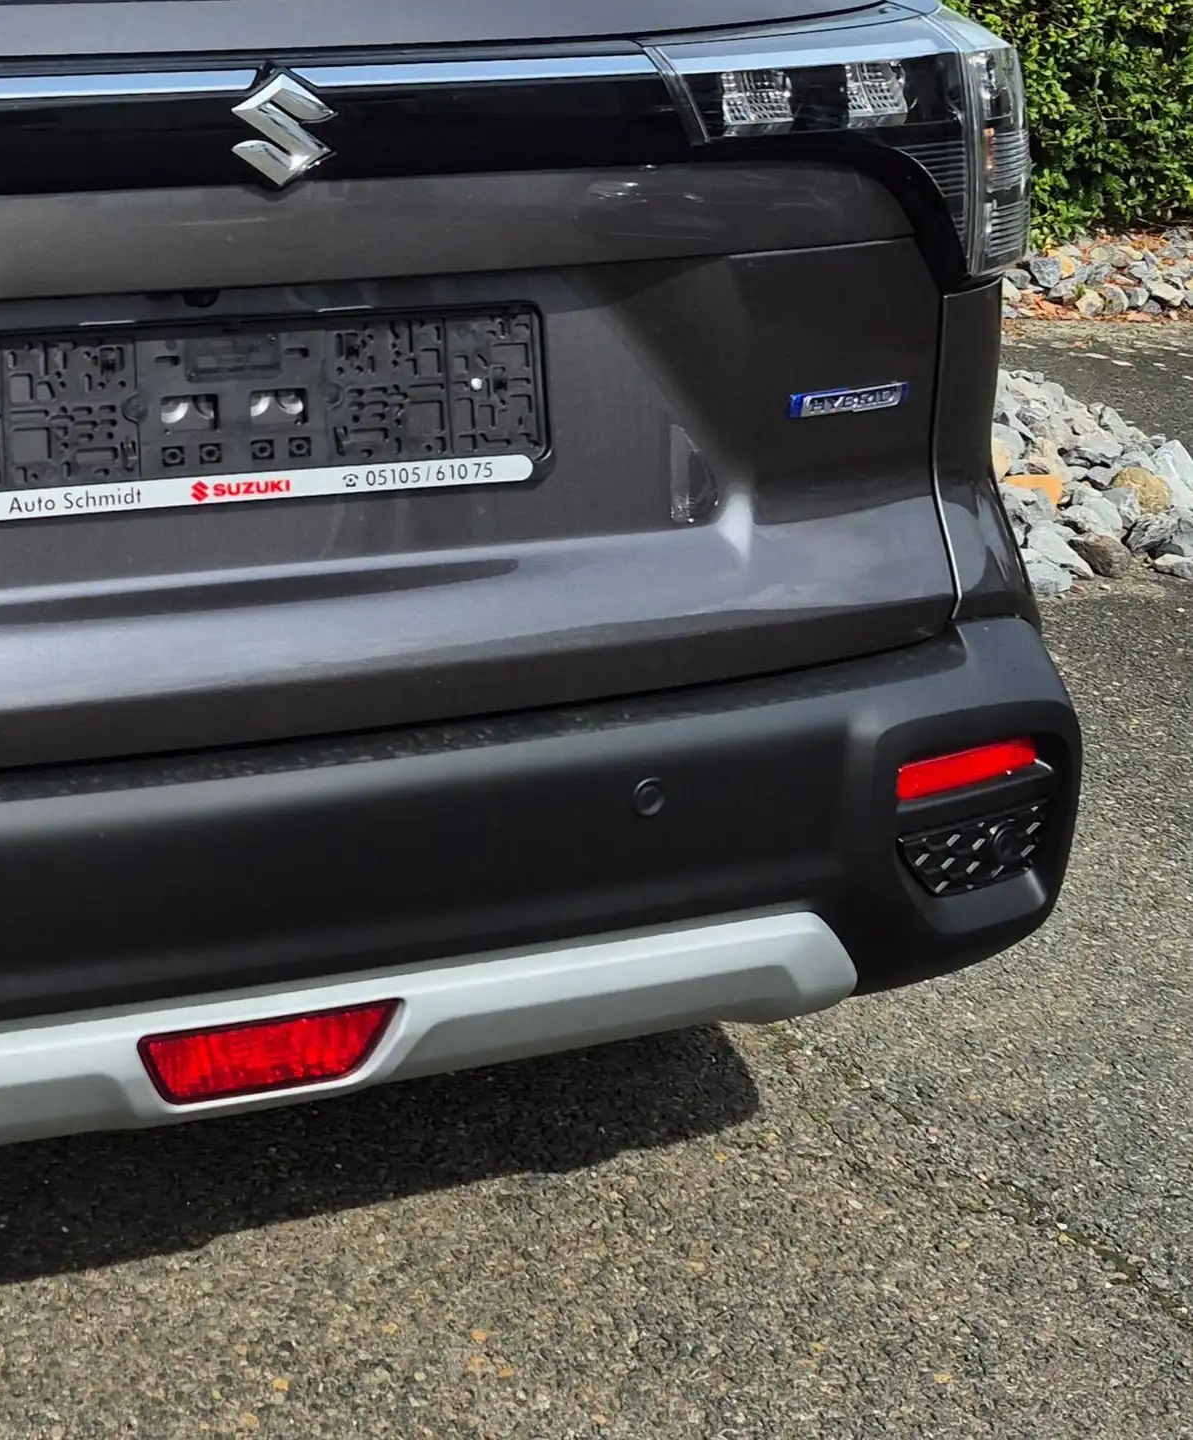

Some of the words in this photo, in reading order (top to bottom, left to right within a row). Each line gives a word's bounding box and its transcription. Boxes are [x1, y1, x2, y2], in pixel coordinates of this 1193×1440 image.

[8, 496, 56, 514] Auto
[63, 488, 142, 510] Schmidt
[213, 479, 291, 497] SUZUKI
